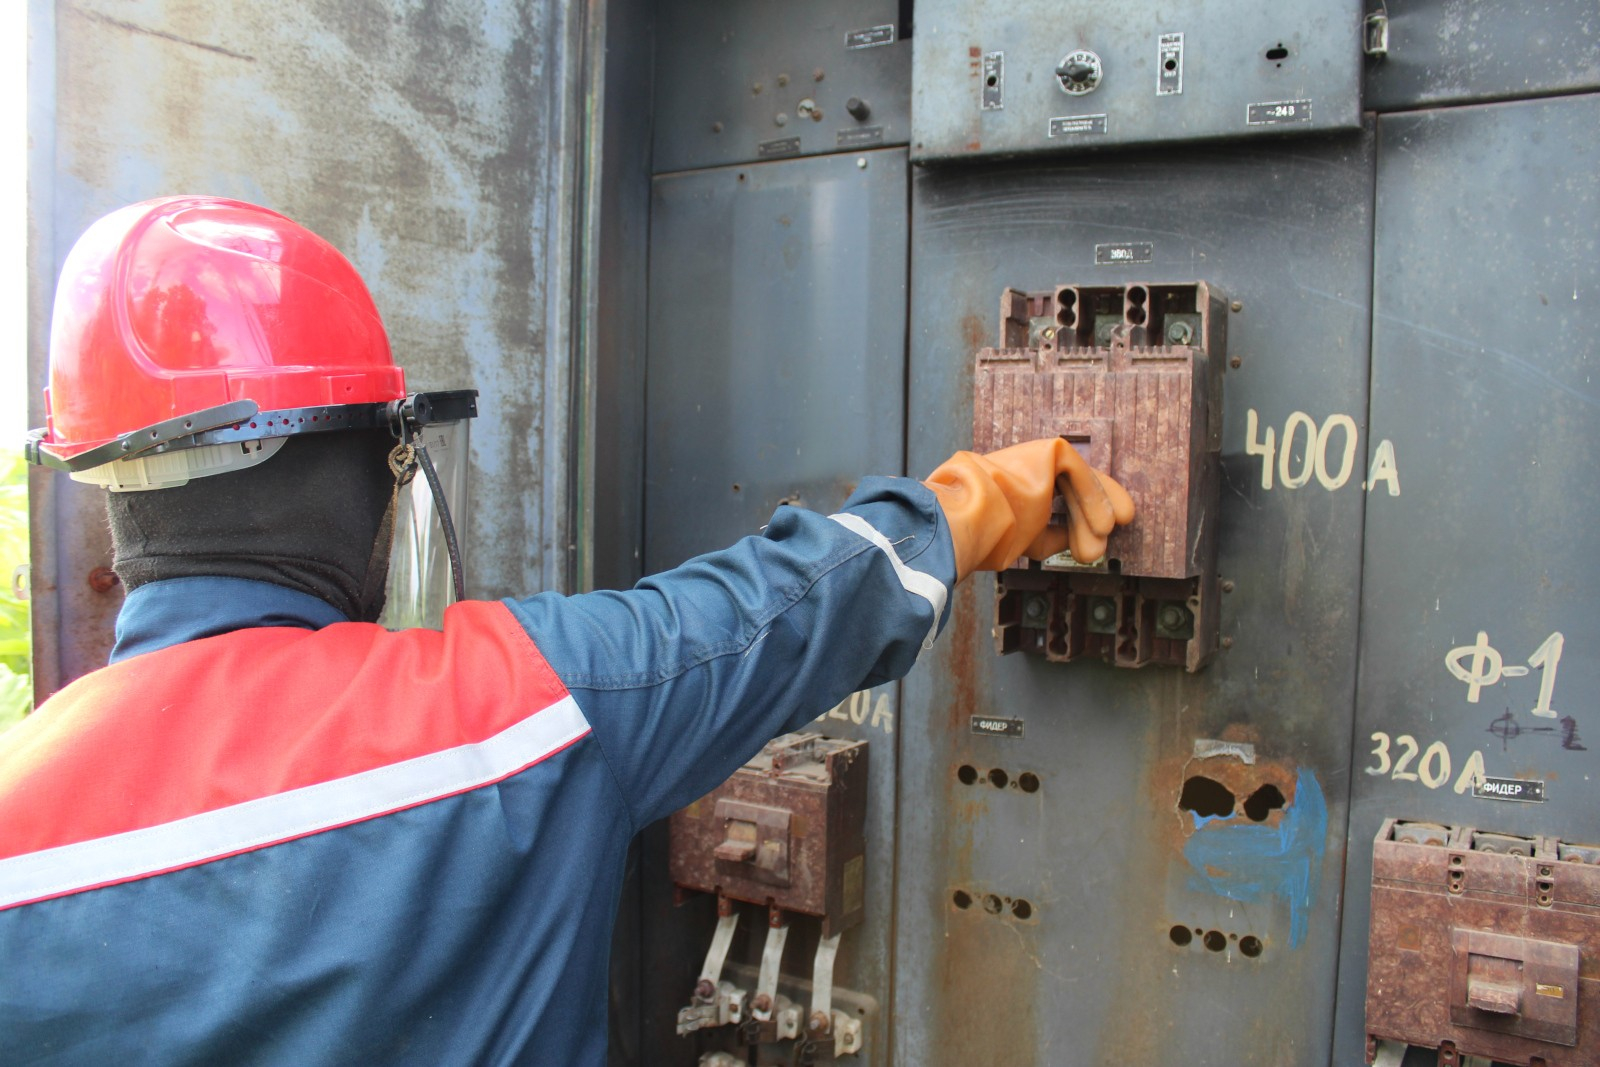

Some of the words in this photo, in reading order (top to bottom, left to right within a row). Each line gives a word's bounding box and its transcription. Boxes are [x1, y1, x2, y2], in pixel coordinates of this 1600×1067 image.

[1445, 630, 1564, 719] Ф-1
[815, 689, 893, 734] 20А
[979, 720, 1008, 731] ФИДЕР
[1483, 783, 1522, 796] ФИДЕР
